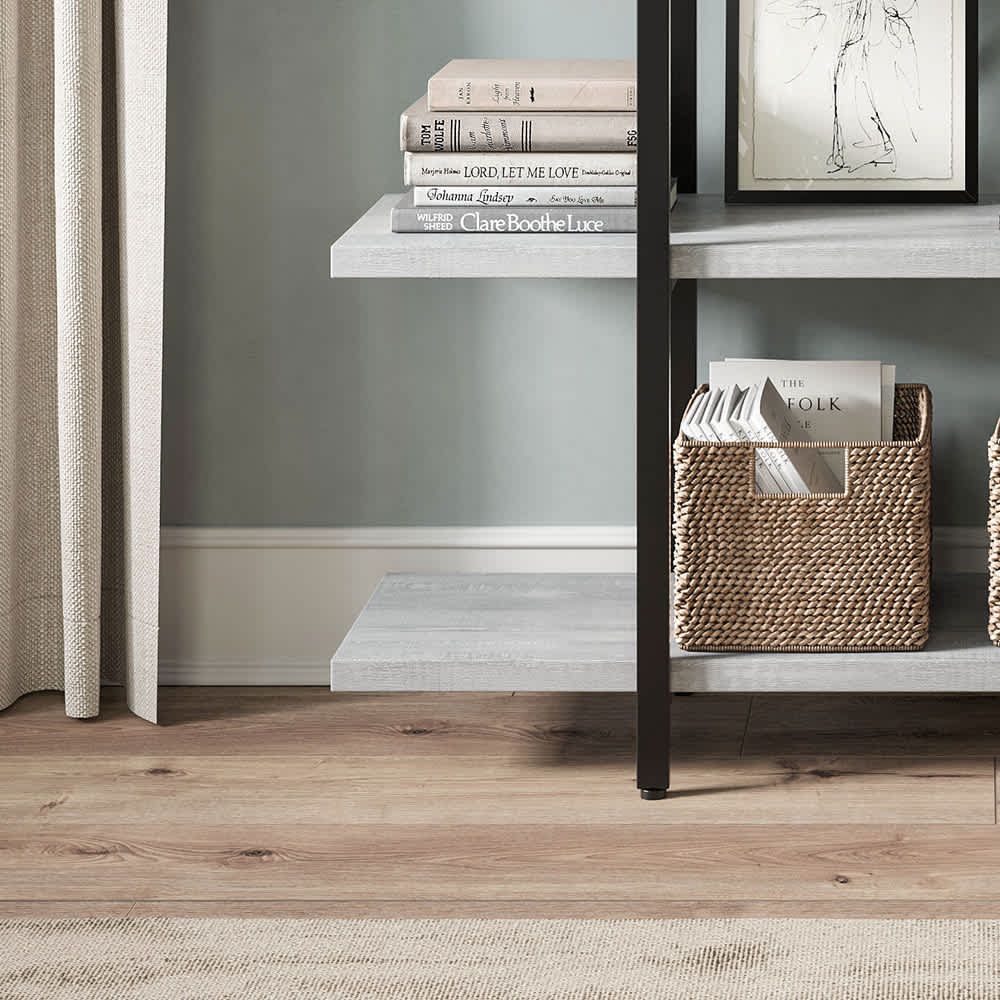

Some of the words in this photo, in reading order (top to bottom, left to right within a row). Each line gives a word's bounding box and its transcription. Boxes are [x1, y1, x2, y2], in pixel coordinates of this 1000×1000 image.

[421, 124, 431, 146] TOM
[434, 119, 445, 152] WOLFE
[464, 166, 499, 181] LORD,
[502, 167, 525, 178] LET
[526, 167, 545, 178] ME
[548, 167, 579, 178] LOVE
[427, 188, 473, 202] Johanna
[476, 189, 514, 204] Lindsey
[416, 214, 453, 222] WILFRID
[460, 212, 506, 232] Clare
[507, 214, 566, 232] Boothe
[567, 214, 604, 232] Luce
[423, 222, 453, 231] SHEED
[780, 379, 805, 388] THE
